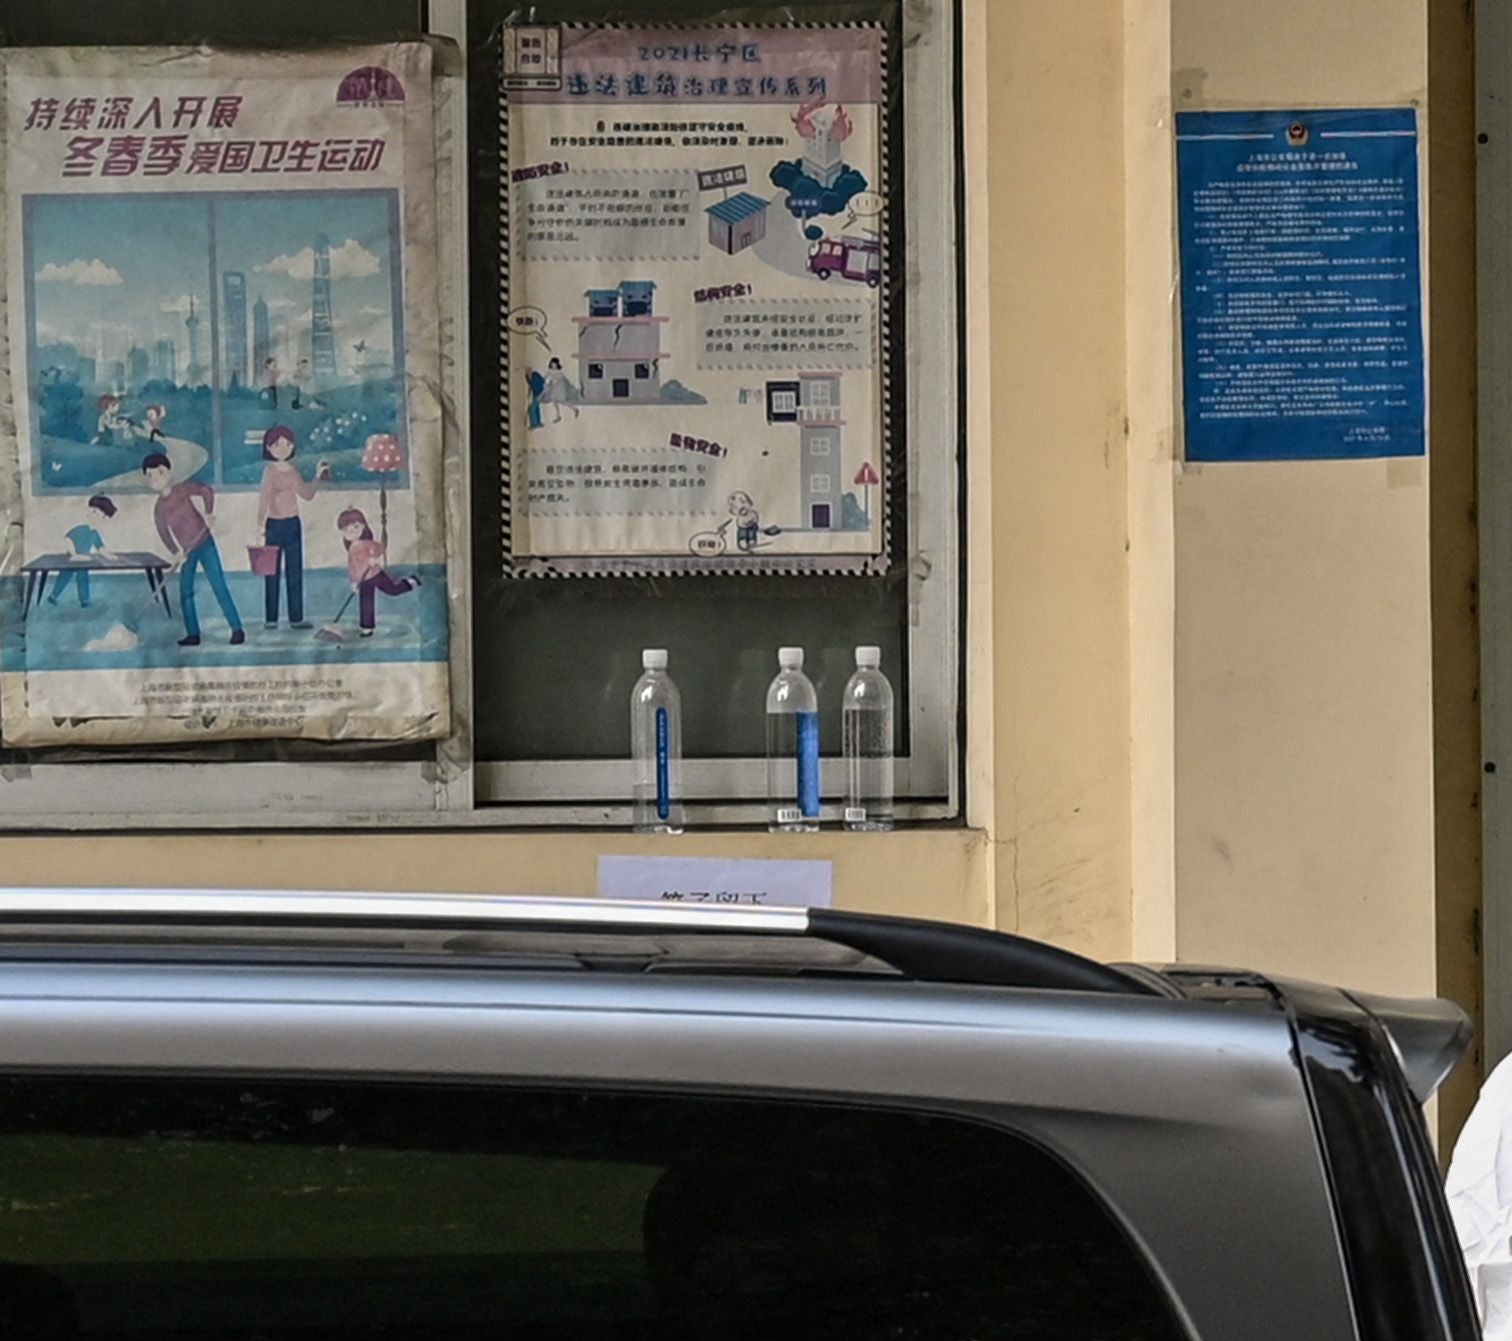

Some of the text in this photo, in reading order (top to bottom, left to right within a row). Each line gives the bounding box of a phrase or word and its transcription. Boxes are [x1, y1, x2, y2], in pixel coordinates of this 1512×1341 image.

[24, 95, 244, 131] 持续深入开展
[62, 134, 386, 177] 冬春季爱国卫生运动
